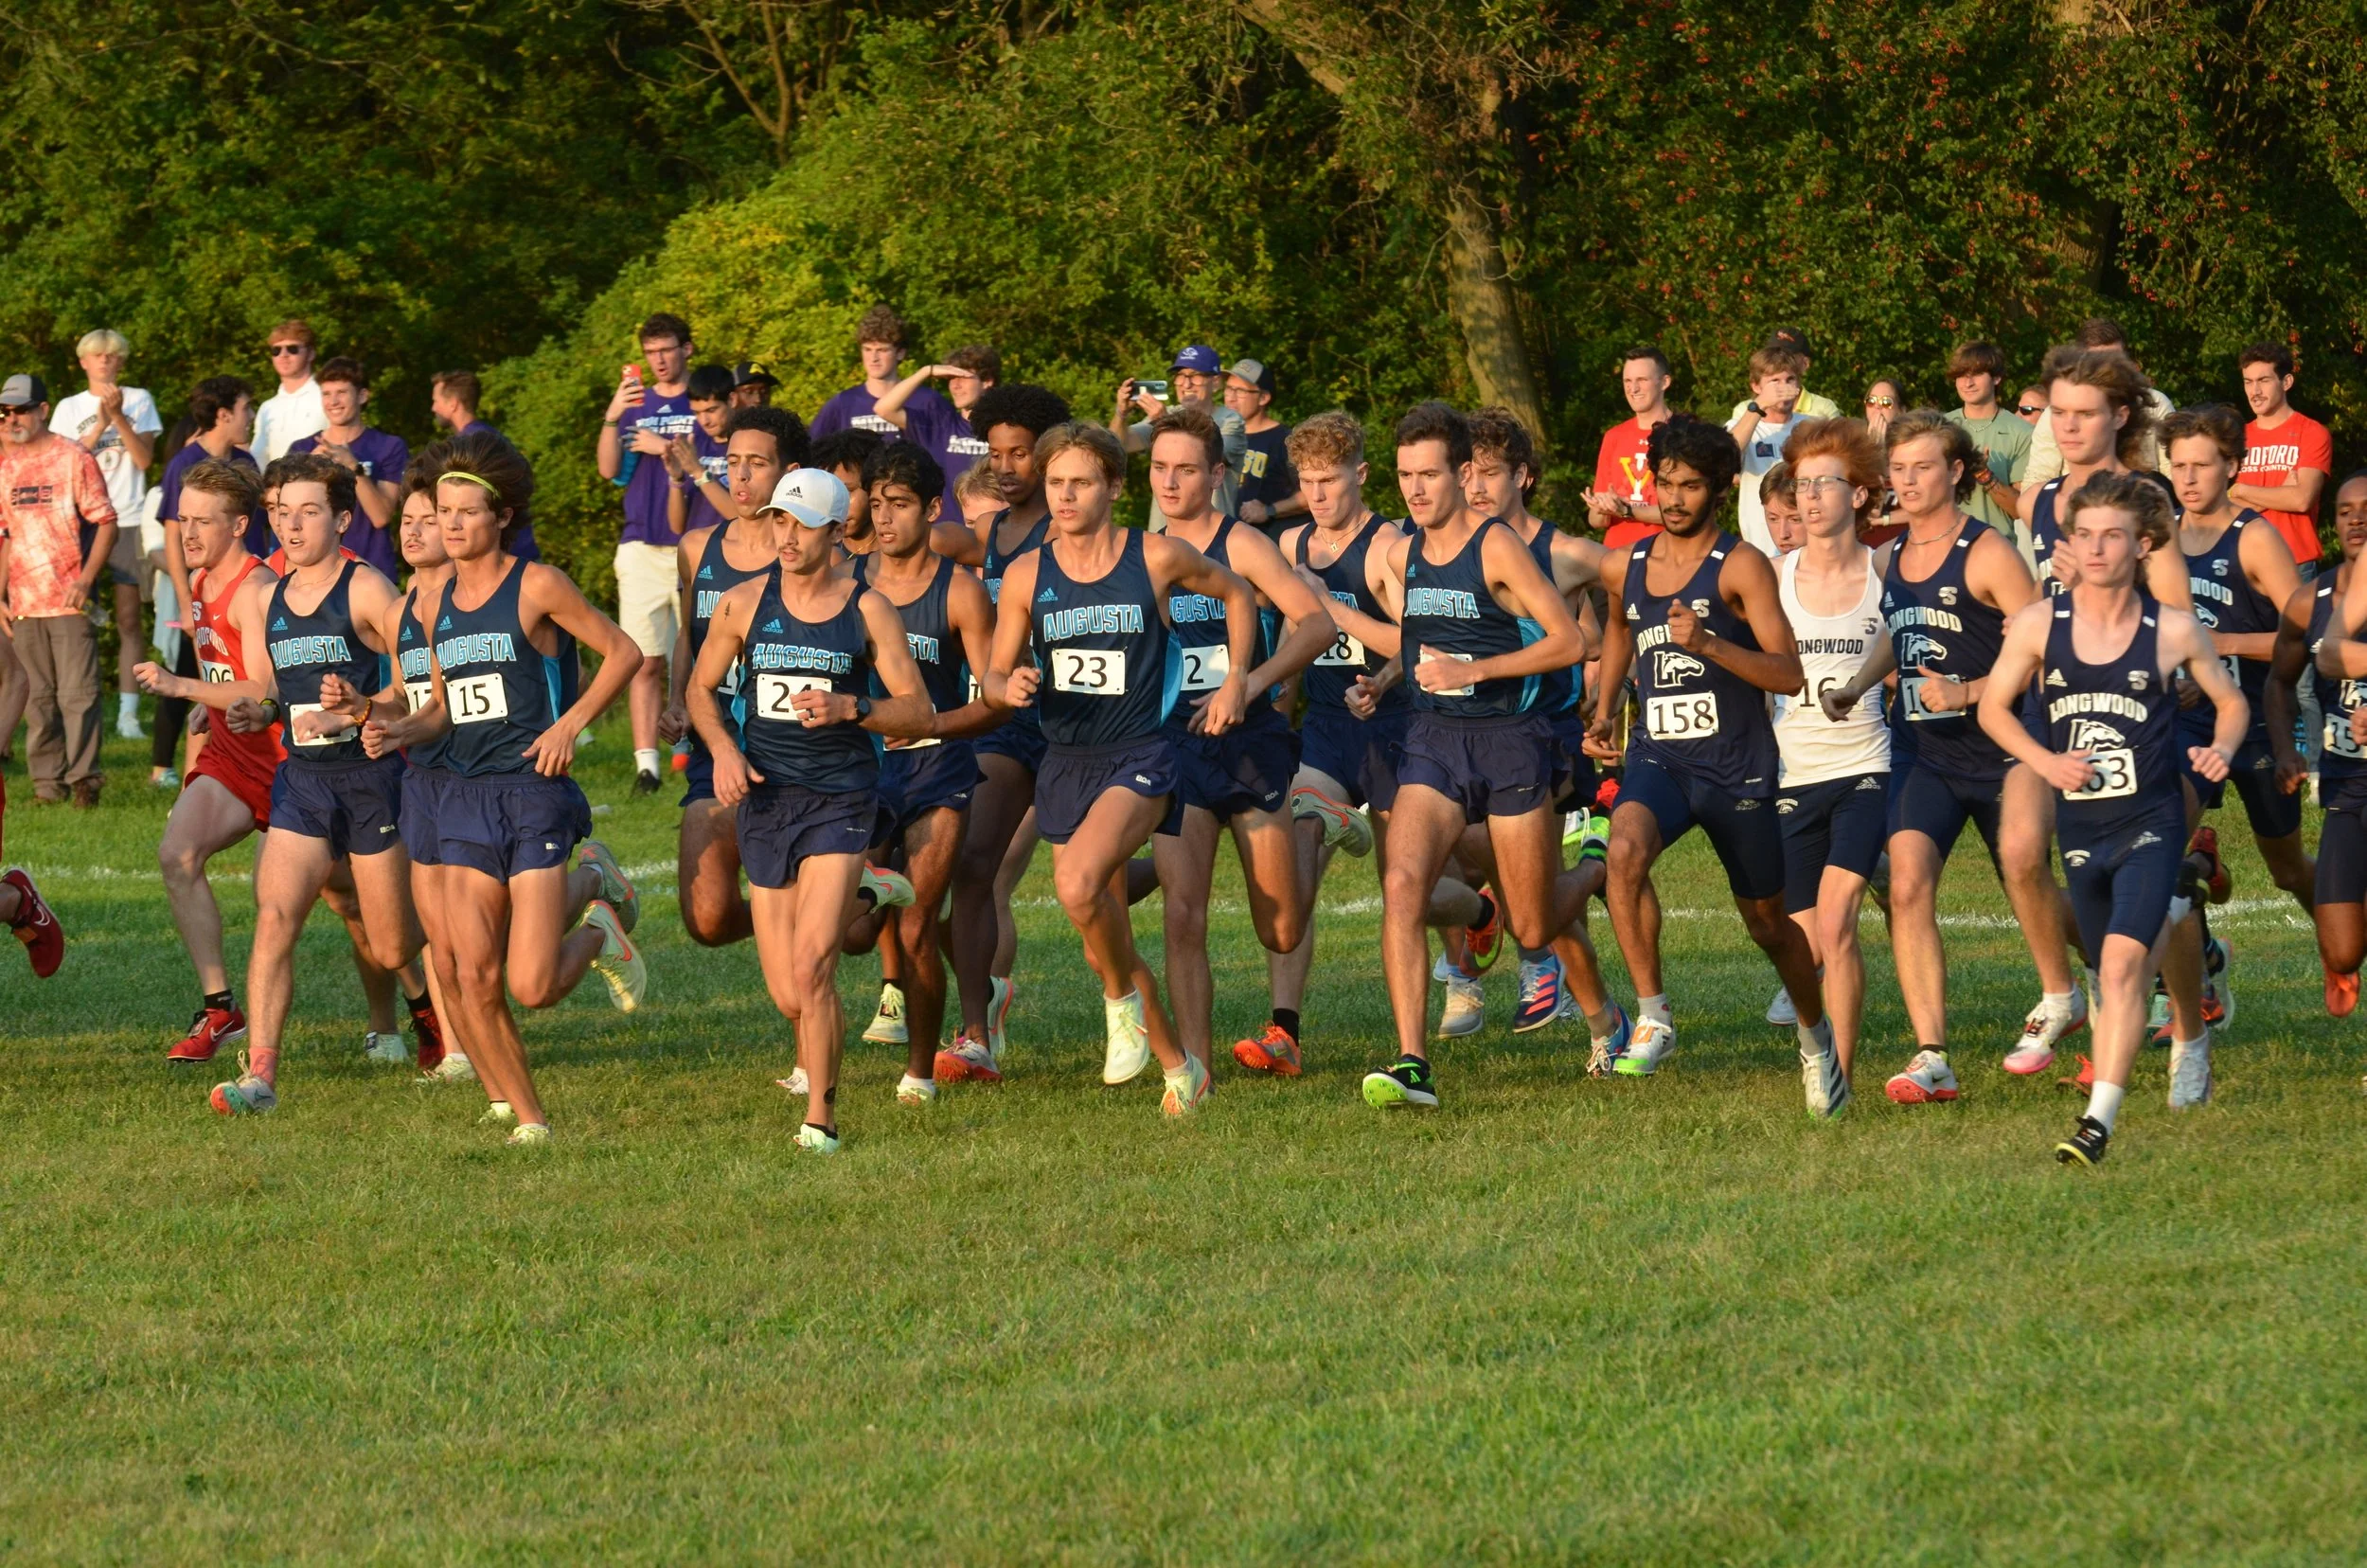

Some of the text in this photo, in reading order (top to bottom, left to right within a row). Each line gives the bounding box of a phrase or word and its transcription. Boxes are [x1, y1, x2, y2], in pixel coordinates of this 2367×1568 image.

[1404, 587, 1480, 618] AUGUSTA
[1043, 604, 1145, 642] AUGUSTA
[1886, 606, 1963, 637] LONGWOOD
[270, 635, 352, 670] AUGUSTA
[436, 633, 517, 671] AUGUSTA
[752, 643, 853, 675] AUGUSTA
[1797, 638, 1863, 654] ONGWOOD
[1068, 655, 1108, 687] 23
[459, 683, 490, 717] 15
[2049, 692, 2148, 724] LONGWOOD
[1653, 700, 1715, 735] 158
